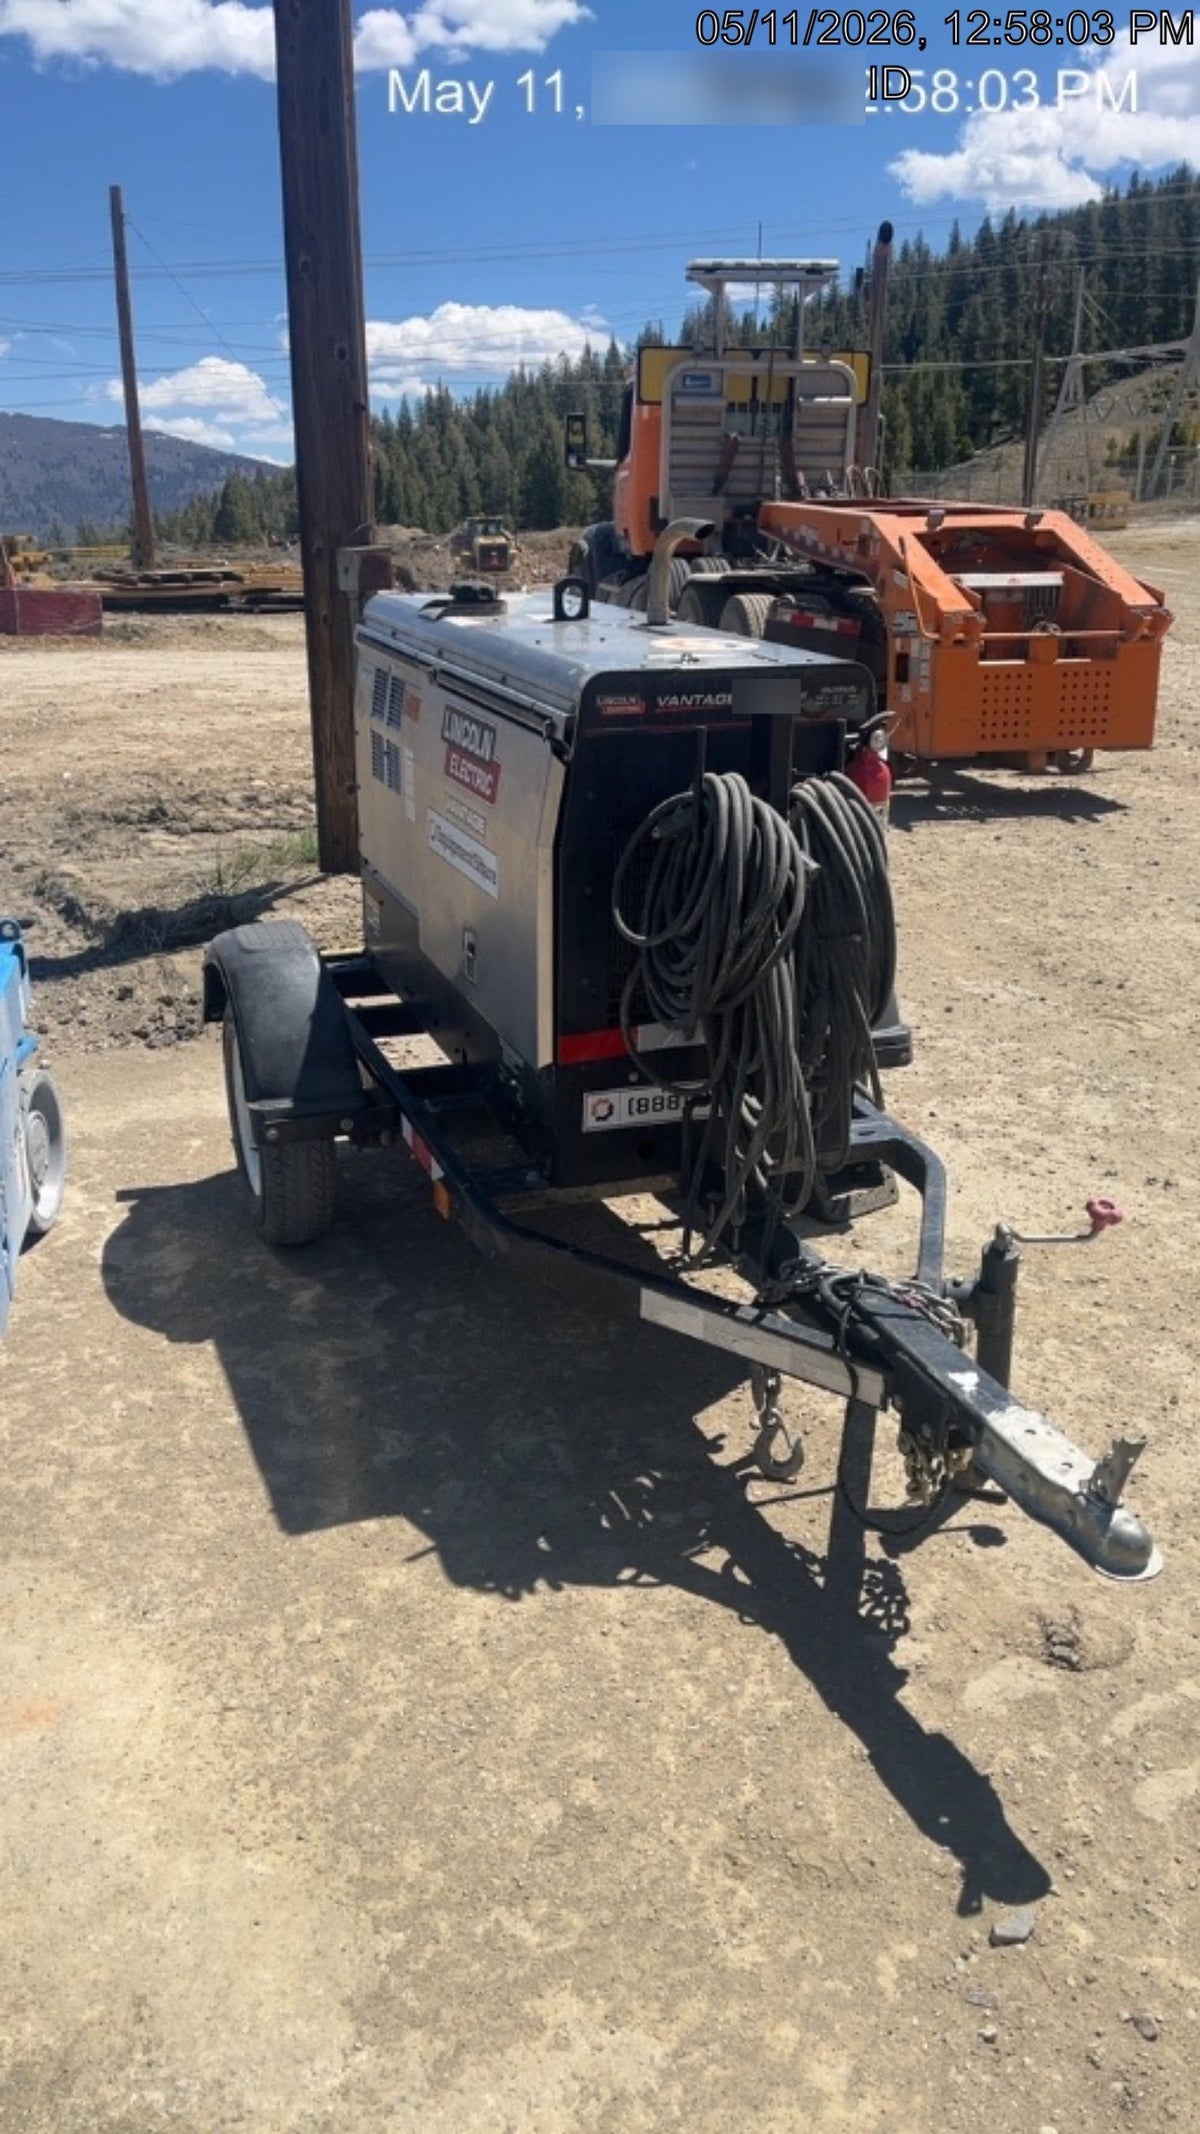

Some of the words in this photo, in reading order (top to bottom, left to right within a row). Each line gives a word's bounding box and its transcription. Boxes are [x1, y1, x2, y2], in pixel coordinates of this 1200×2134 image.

[444, 709, 494, 763] LINCOLN
[449, 752, 495, 797] ELECTRIC
[627, 1094, 686, 1117] (888
